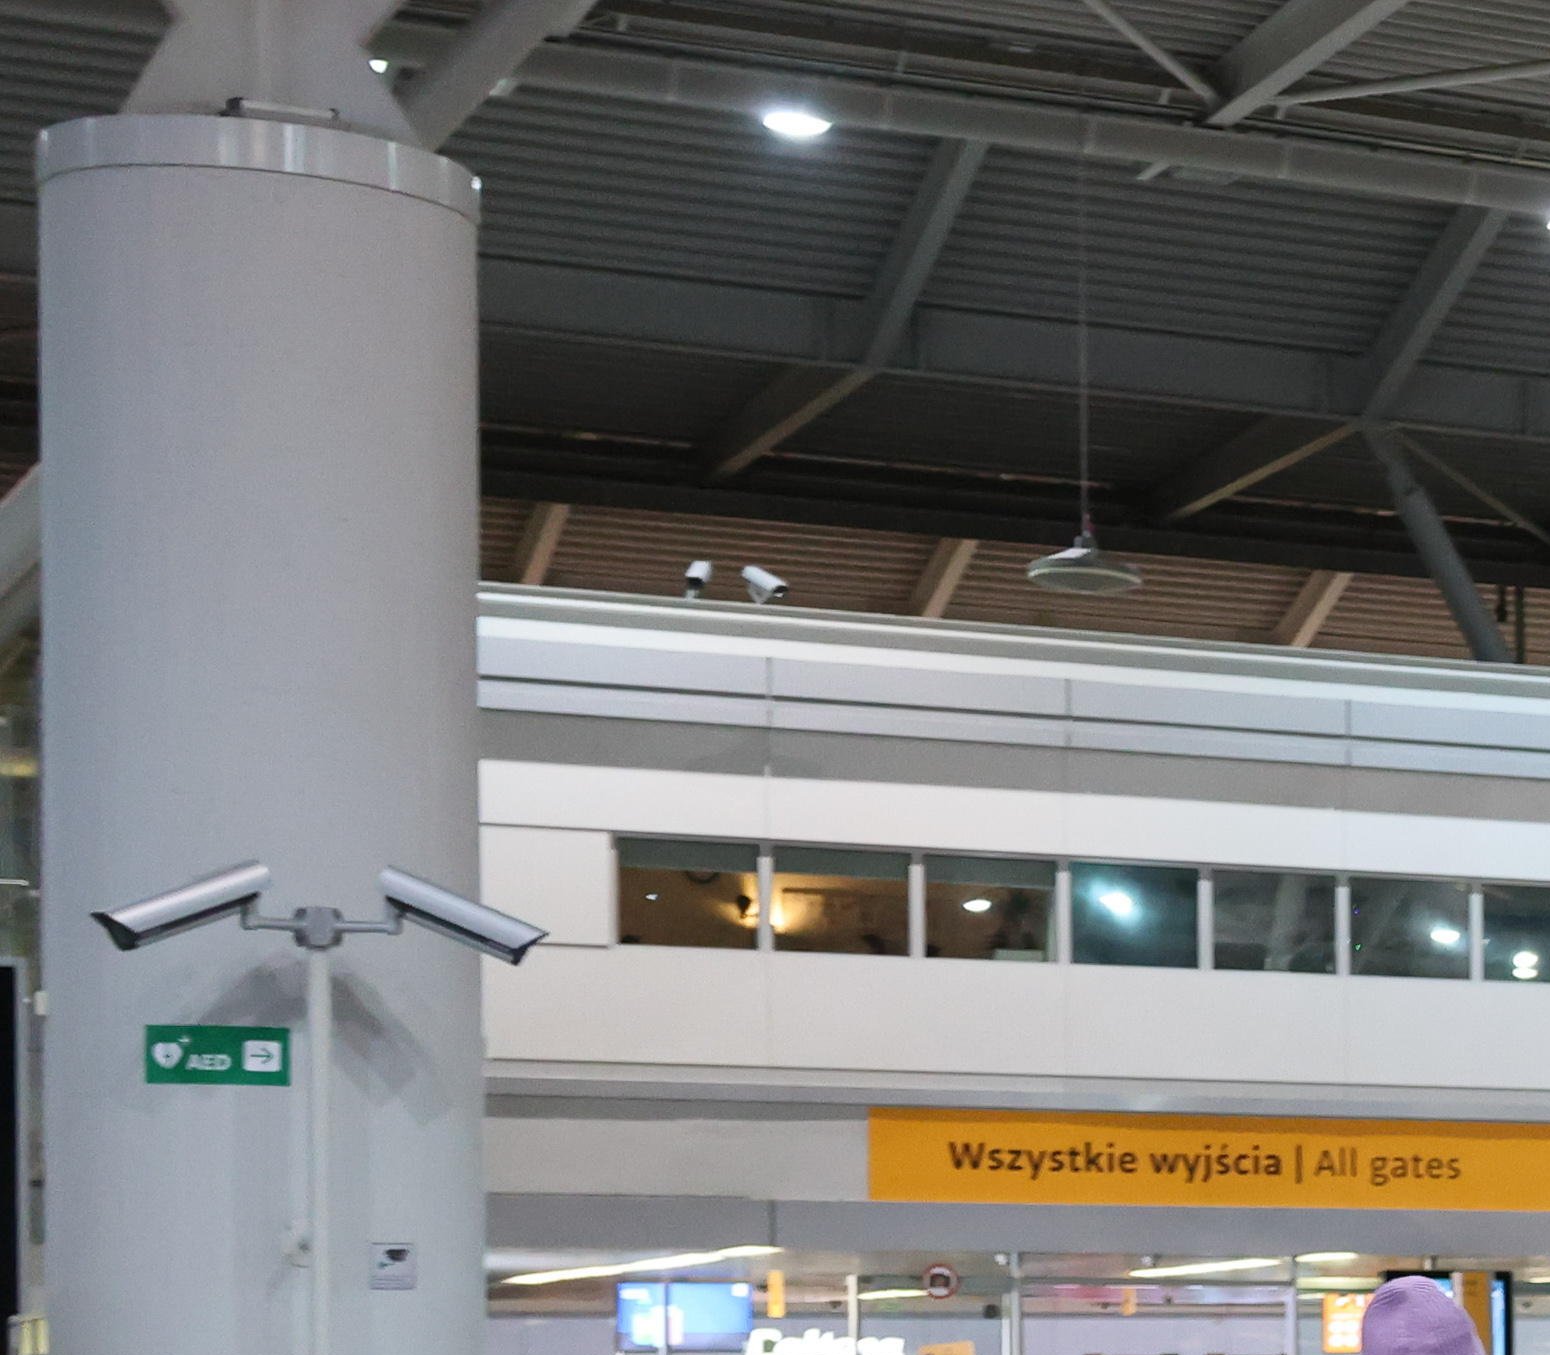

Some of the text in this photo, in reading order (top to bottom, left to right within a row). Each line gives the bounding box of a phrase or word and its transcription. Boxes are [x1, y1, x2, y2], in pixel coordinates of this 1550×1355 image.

[185, 1054, 232, 1071] AED
[949, 1141, 1462, 1186] Wszystkie wyjścia All gates
